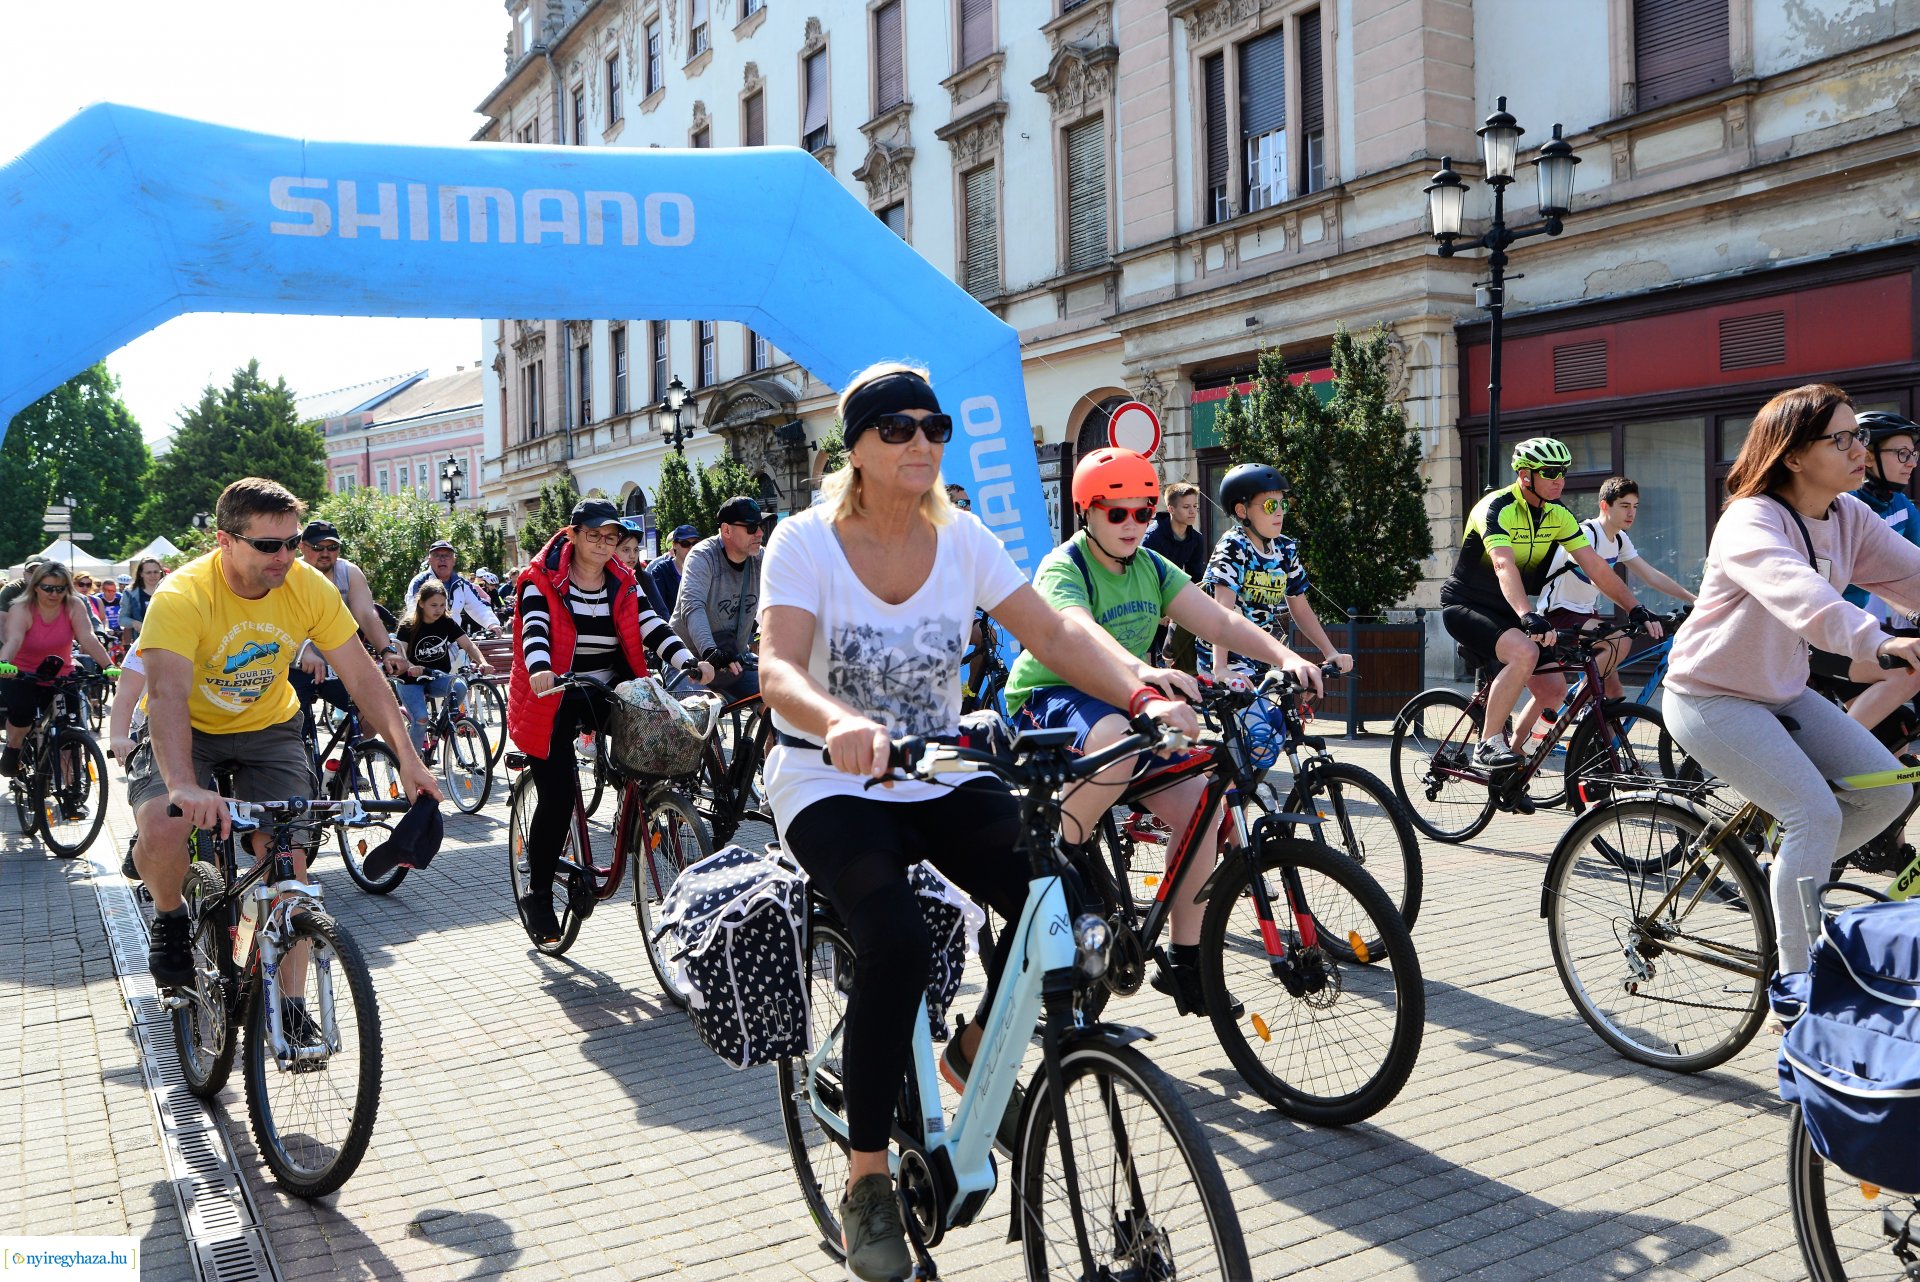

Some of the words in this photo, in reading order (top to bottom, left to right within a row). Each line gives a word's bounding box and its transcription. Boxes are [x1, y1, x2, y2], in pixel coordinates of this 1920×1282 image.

[268, 175, 696, 247] SHIMANO
[418, 646, 445, 658] NASA
[234, 669, 259, 680] TOUR
[260, 668, 273, 677] DE
[1896, 771, 1914, 780] Hard
[1897, 860, 1920, 893] GA
